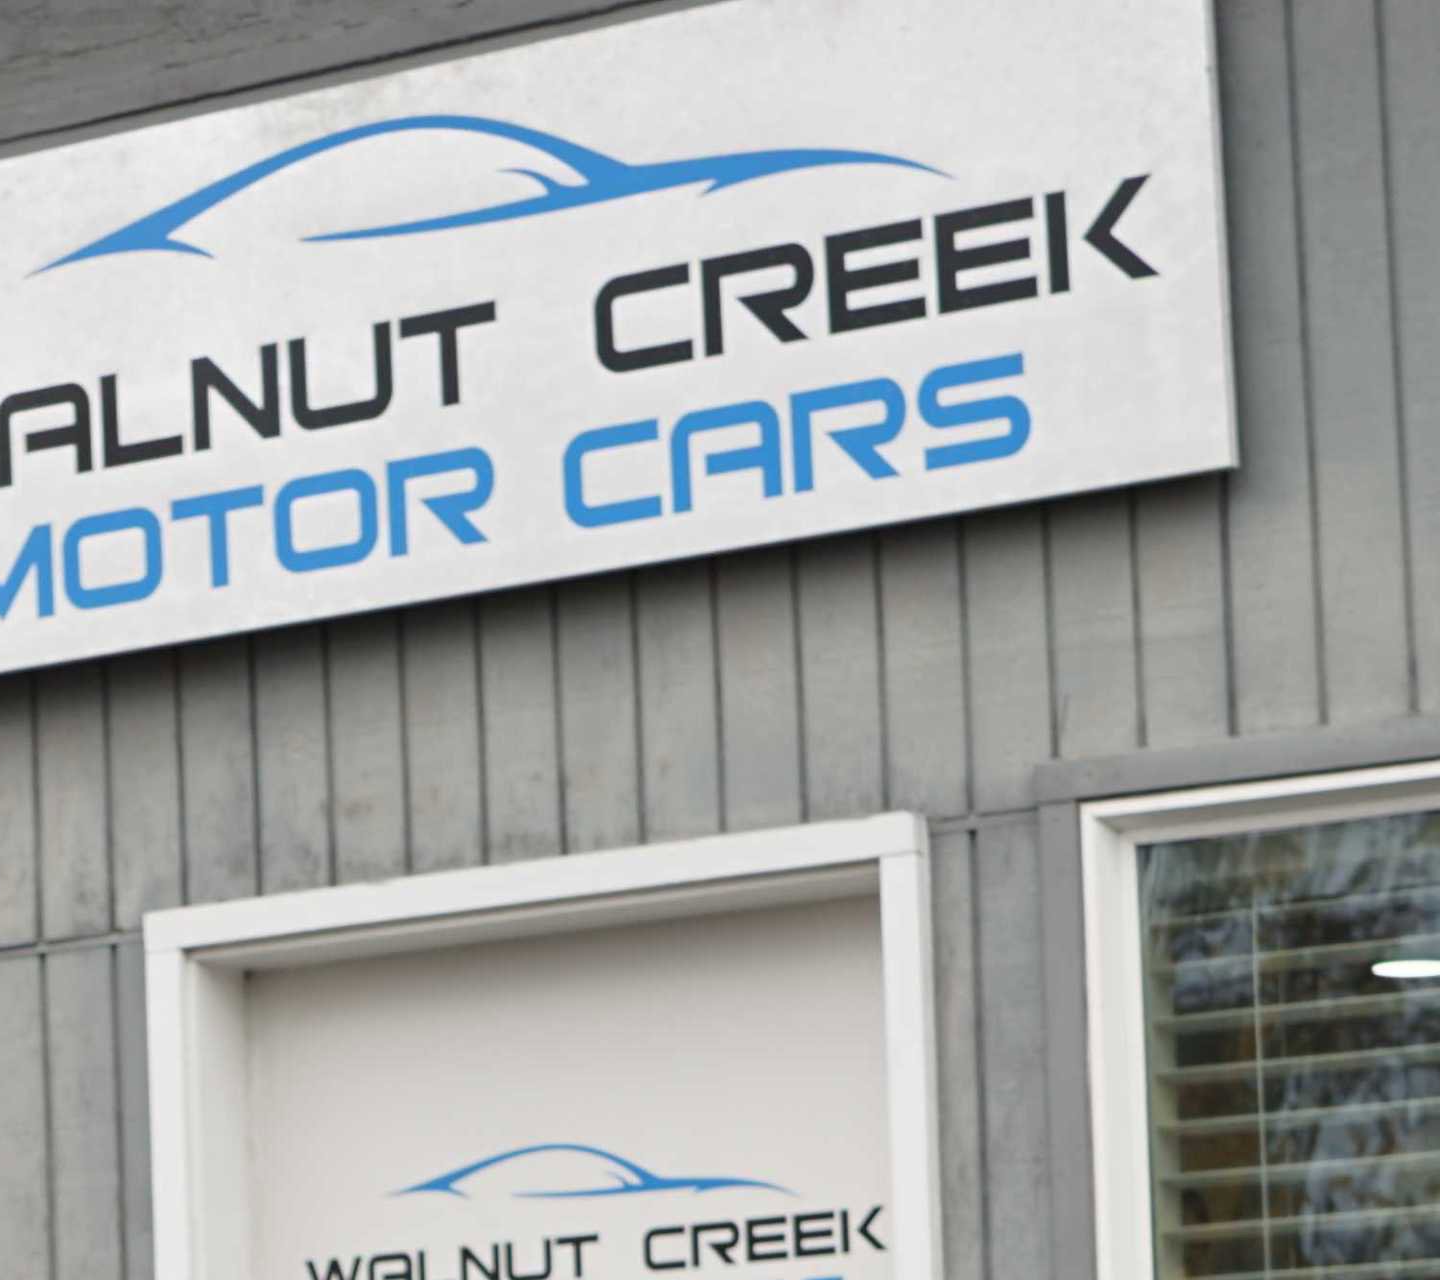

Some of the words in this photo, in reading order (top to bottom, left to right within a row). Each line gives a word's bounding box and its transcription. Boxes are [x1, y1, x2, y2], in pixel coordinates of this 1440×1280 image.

[593, 174, 1160, 374] CREEK
[562, 351, 1032, 529] CARS
[643, 1205, 887, 1271] CREEK
